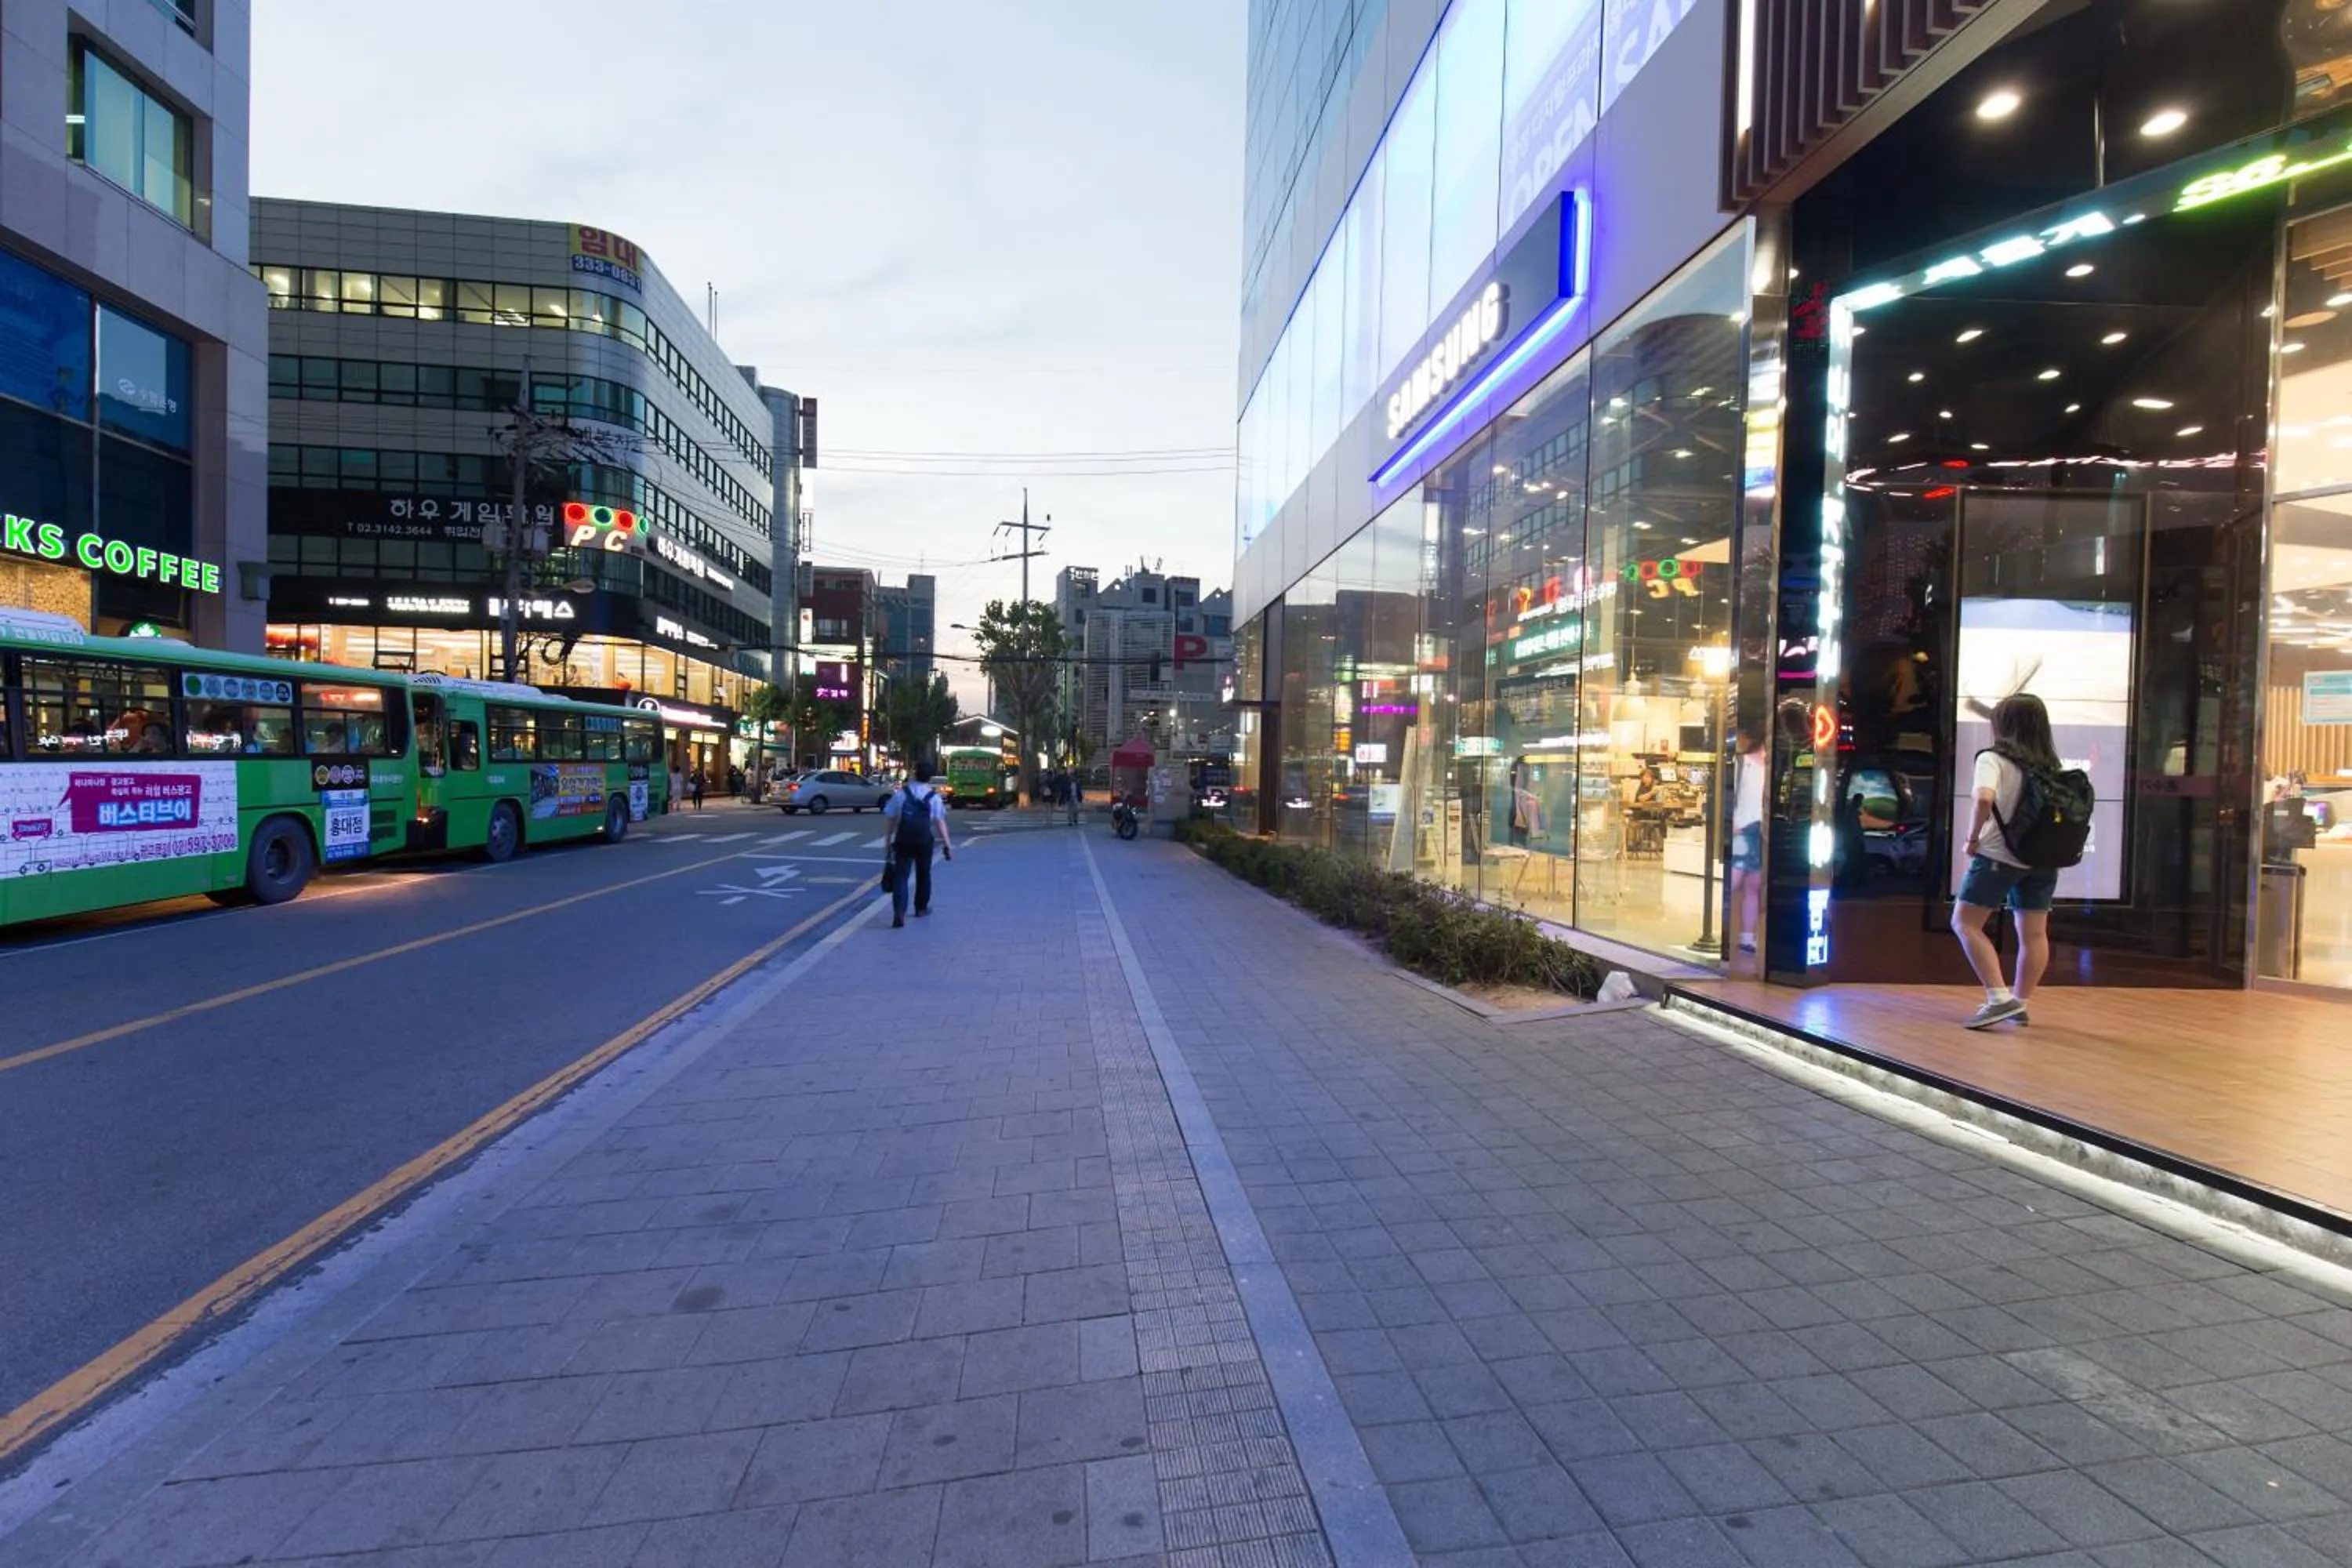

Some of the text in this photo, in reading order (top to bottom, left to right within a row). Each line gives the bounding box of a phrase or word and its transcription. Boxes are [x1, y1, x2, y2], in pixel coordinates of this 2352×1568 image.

[579, 226, 637, 271] 임대
[1388, 282, 1507, 439] SAMSUNG
[390, 499, 441, 520] 하우
[0, 514, 220, 593] KS COFFEE
[98, 797, 192, 826] 버스티브이
[331, 816, 363, 837] 홍대점
